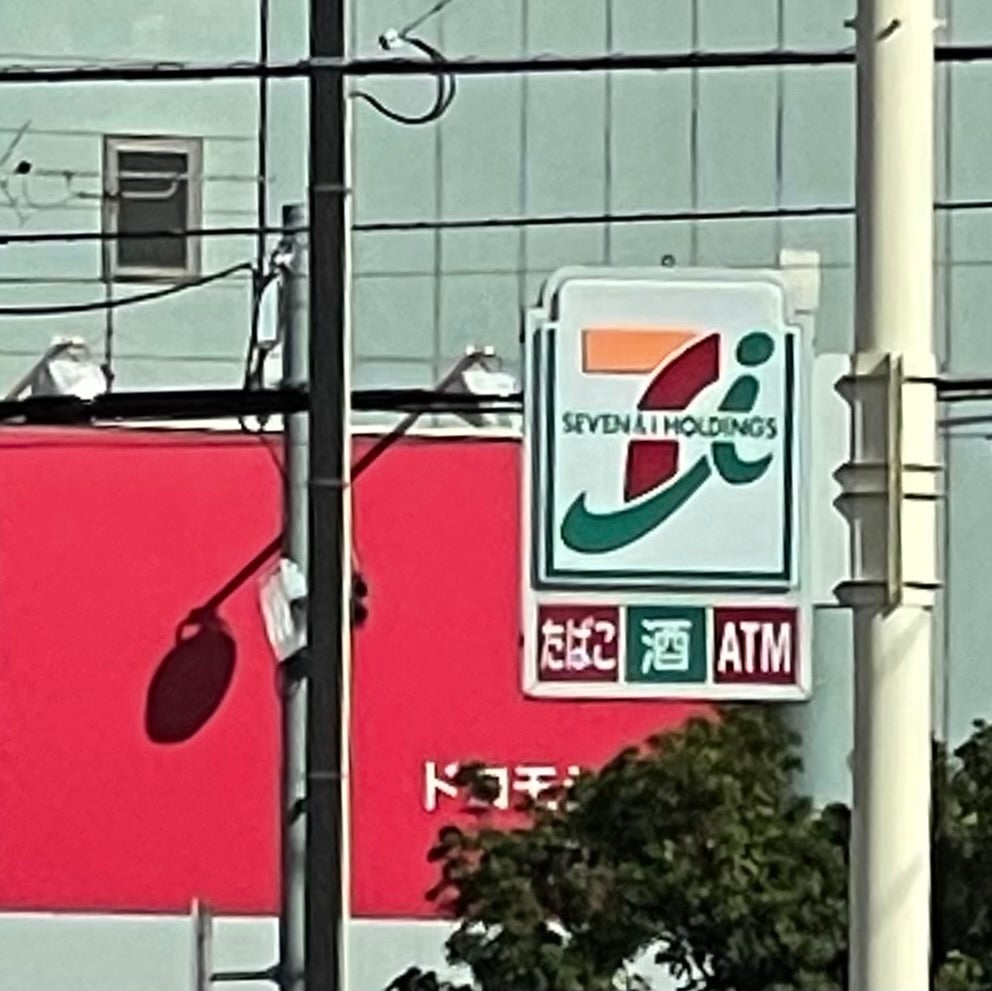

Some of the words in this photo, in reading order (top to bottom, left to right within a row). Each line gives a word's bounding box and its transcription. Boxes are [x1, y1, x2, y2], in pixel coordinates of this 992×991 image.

[562, 412, 630, 435] SEVEN
[664, 414, 777, 439] HOLDINGS
[541, 616, 616, 671] たばこ
[641, 618, 693, 674] 酒
[717, 621, 791, 674] ATM
